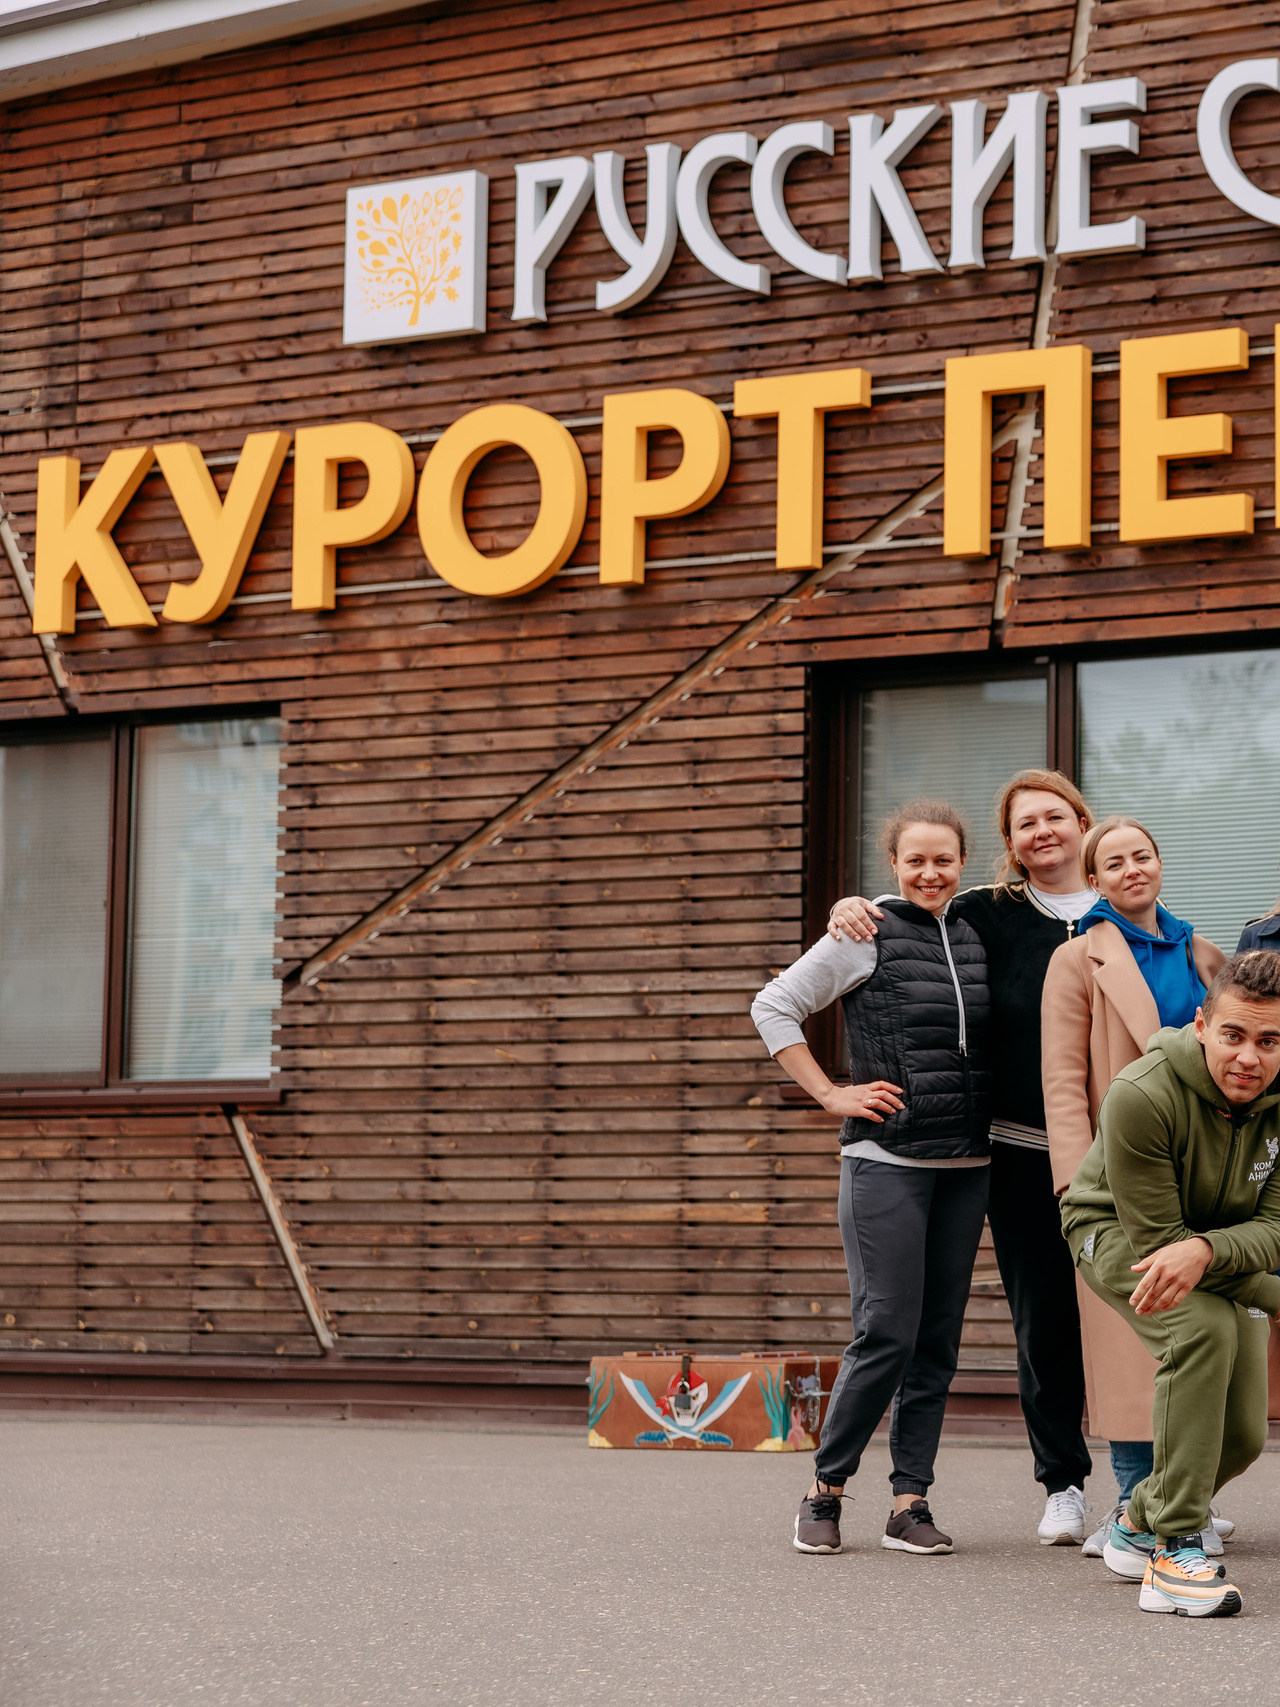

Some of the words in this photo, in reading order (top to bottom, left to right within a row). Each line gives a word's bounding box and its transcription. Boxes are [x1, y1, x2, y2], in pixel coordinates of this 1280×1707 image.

[512, 77, 1147, 322] РУССКИЕ
[34, 369, 871, 634] КУРОРТ
[1253, 1160, 1275, 1171] КОМ
